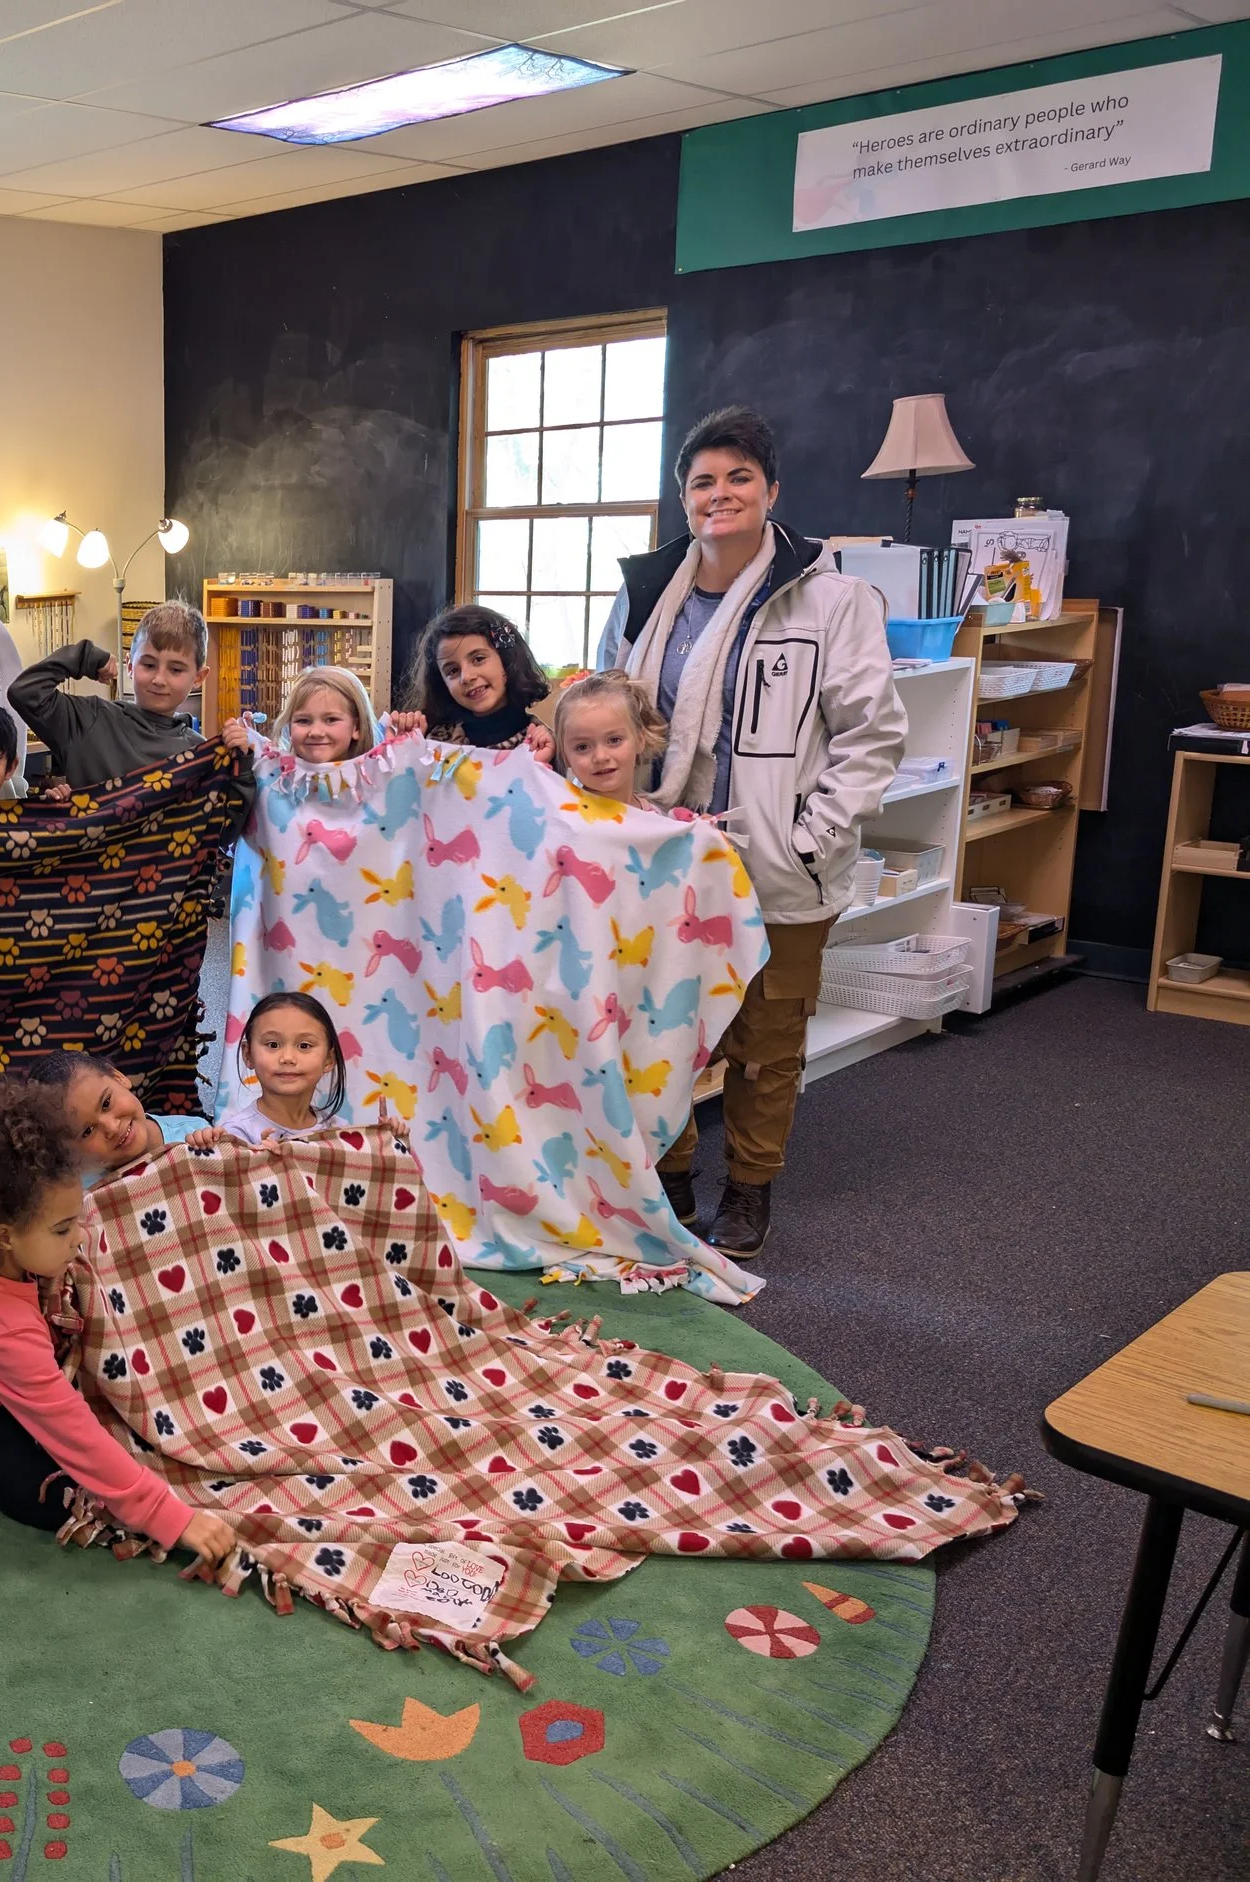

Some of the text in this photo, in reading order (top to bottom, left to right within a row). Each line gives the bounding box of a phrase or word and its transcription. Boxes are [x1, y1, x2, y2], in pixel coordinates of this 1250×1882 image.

[852, 95, 1129, 154] “Heroes are ordinary people who
[853, 120, 1124, 179] make themselves extraordinary”
[1070, 158, 1106, 172] Gerard
[1109, 156, 1132, 168] Way
[466, 1561, 484, 1574] LOVE
